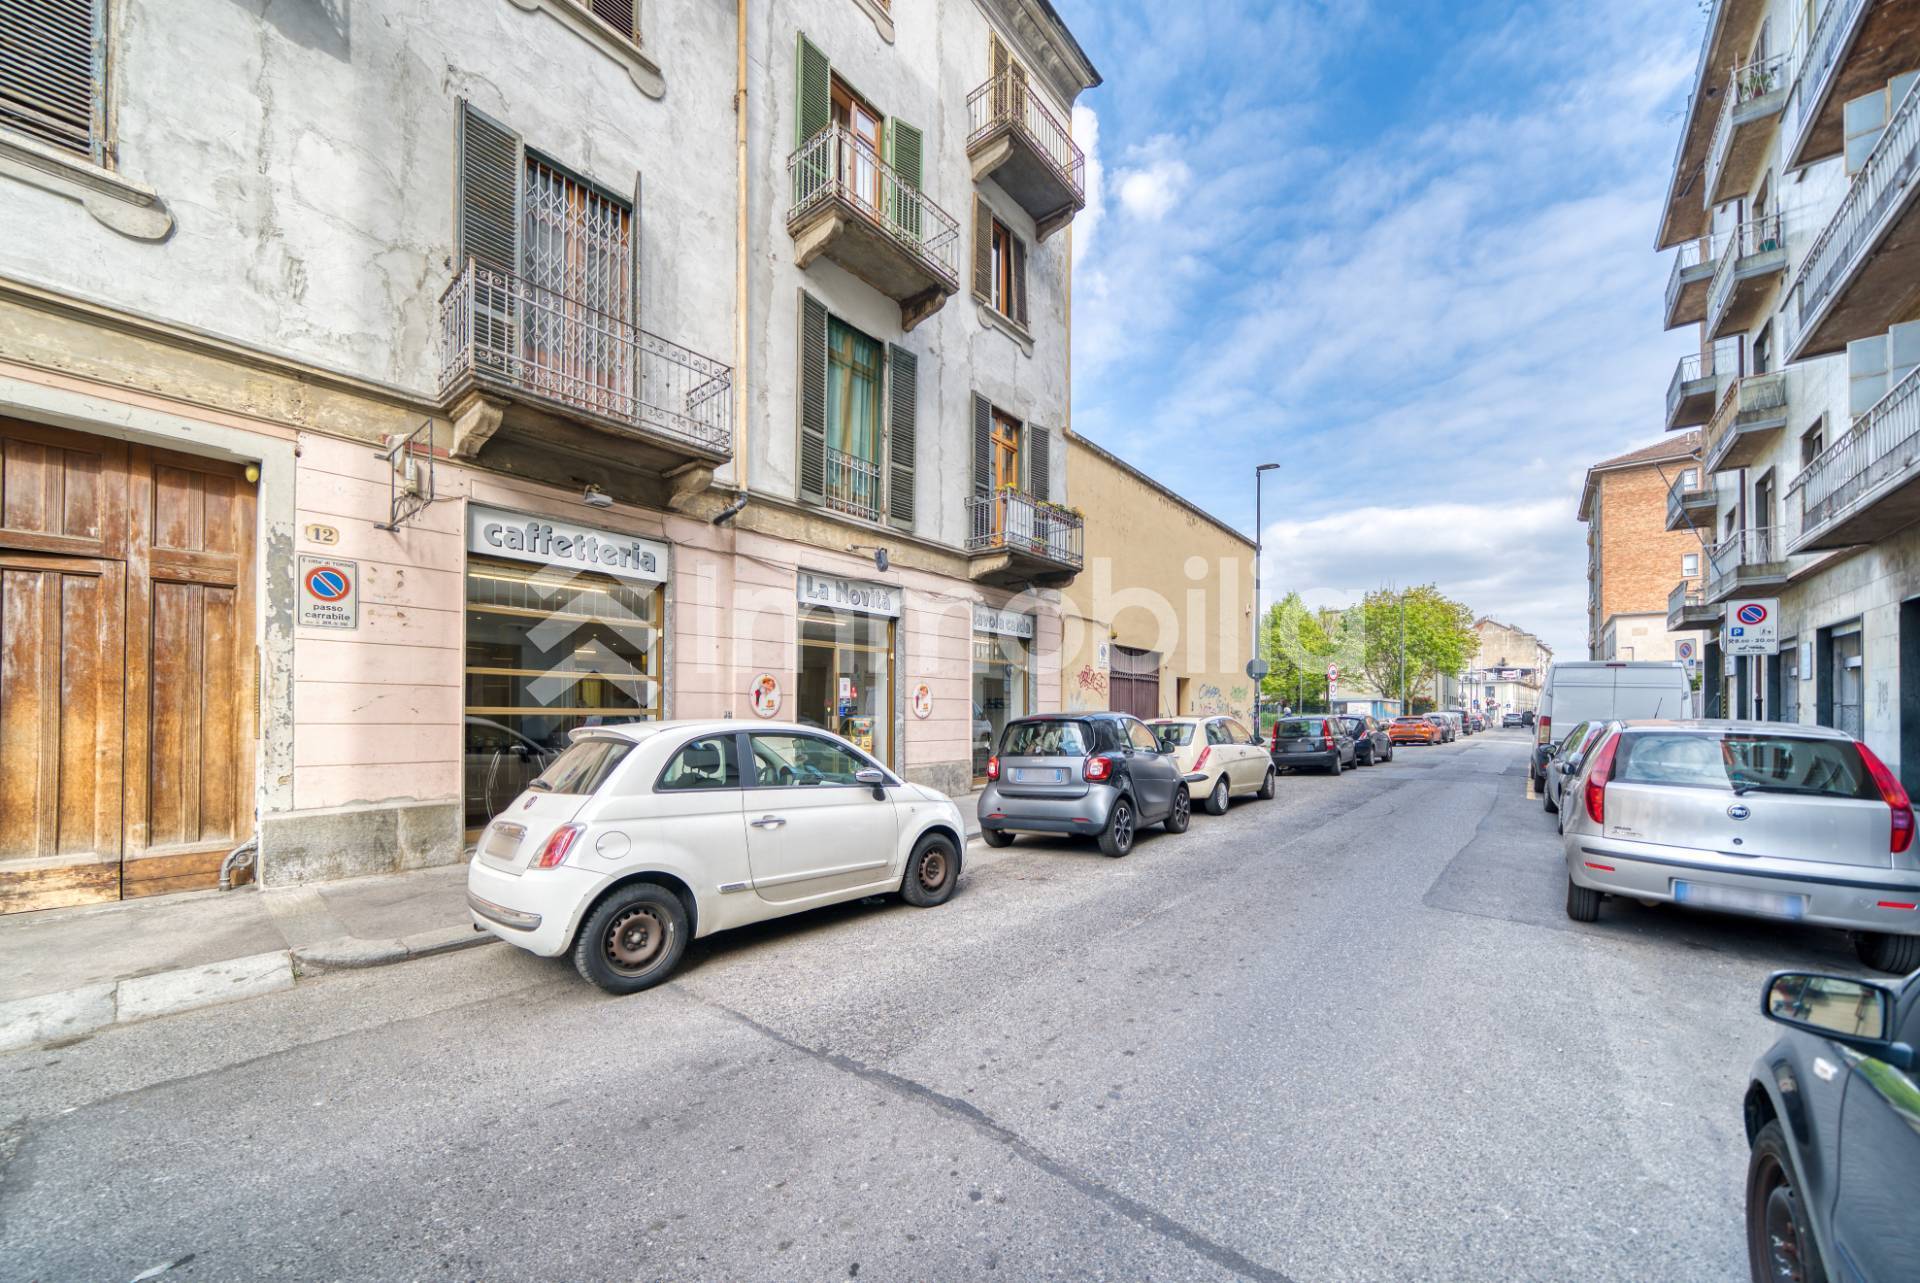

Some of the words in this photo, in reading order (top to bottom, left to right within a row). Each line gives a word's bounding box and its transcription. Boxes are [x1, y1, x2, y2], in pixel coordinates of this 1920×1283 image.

[313, 527, 334, 542] 12
[483, 522, 656, 573] caffetteria
[806, 575, 829, 601] La
[313, 604, 343, 612] passo
[305, 612, 351, 621] carrabile
[1731, 808, 1747, 816] FIAT
